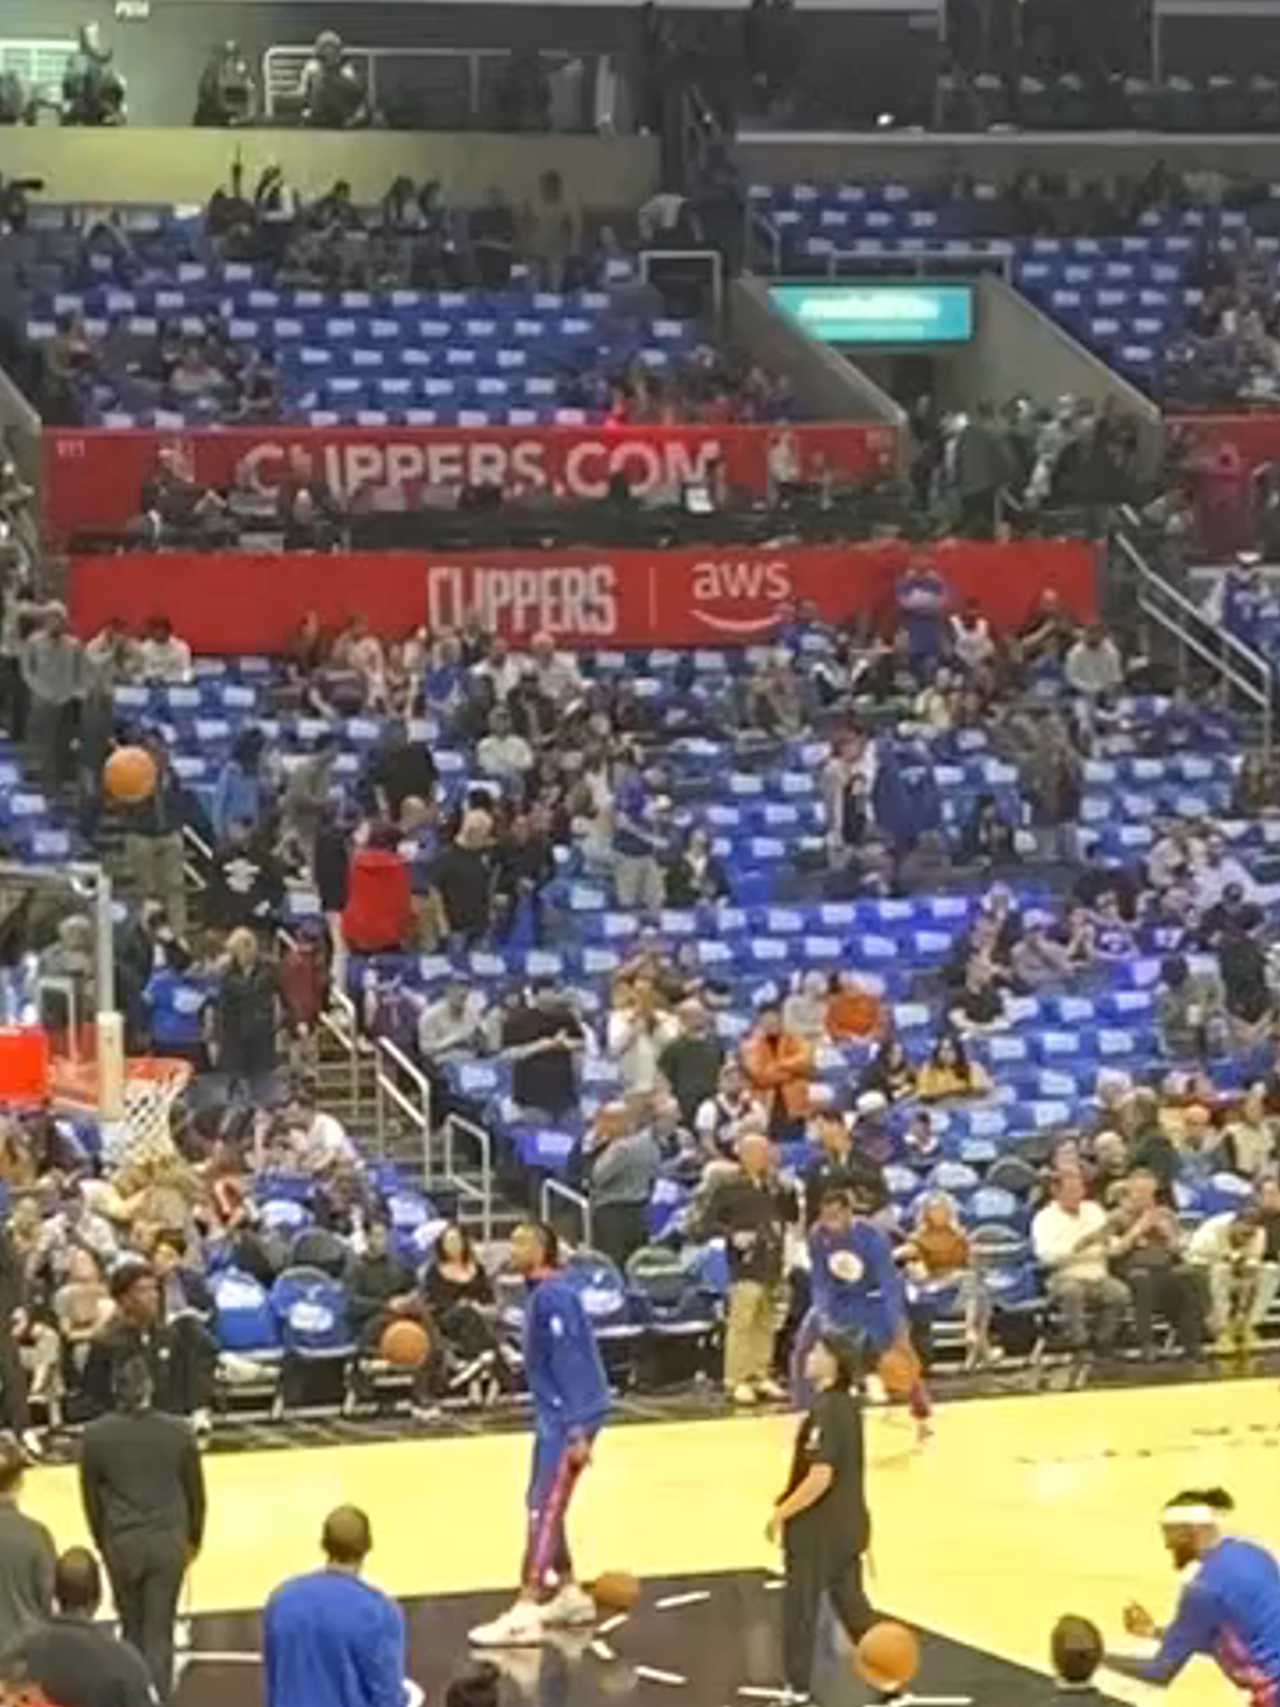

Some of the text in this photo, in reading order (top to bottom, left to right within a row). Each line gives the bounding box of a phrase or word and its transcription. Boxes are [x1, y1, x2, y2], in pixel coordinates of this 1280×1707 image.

[237, 441, 720, 498] CIPPERS.COM
[427, 566, 617, 634] CLIPPERS
[691, 561, 792, 599] aws
